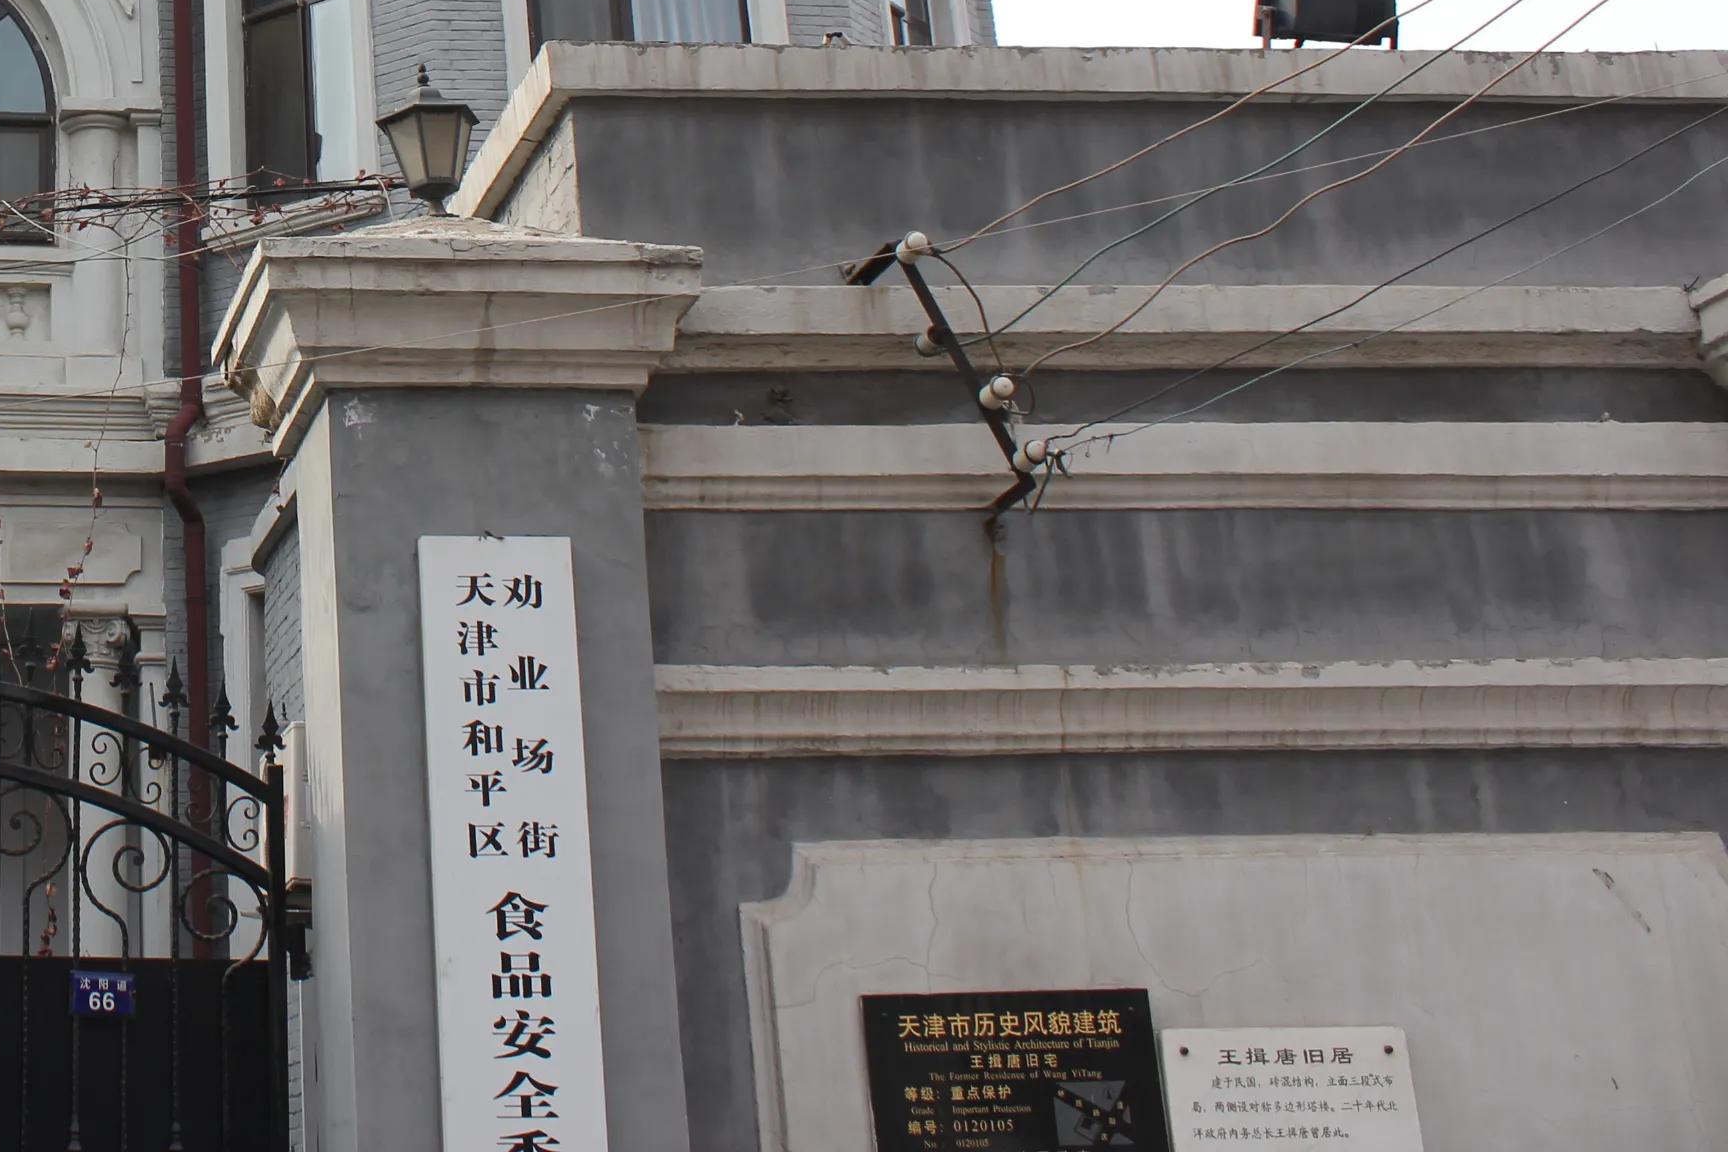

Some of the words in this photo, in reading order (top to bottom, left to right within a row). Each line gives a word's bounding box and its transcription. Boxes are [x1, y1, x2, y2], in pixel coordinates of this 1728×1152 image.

[455, 573, 508, 858] 天津市和平区
[501, 574, 560, 858] 劝业场街
[89, 992, 115, 1011] 66
[898, 1010, 1122, 1039] 天津市历史风貌建筑
[904, 1041, 949, 1053] Historical
[953, 1041, 969, 1051] and
[973, 1039, 1010, 1052] Stylistic
[1014, 1039, 1069, 1050] Architecture
[1073, 1039, 1084, 1048] of
[1087, 1038, 1119, 1050] Tianjin
[970, 1054, 1059, 1069] 王揖唐旧宅
[1218, 1047, 1354, 1065] 王揖唐旧居
[929, 1072, 945, 1081] The
[949, 1072, 979, 1081] Former
[984, 1071, 1025, 1080] Residence
[1030, 1071, 1039, 1080] of
[1042, 1070, 1067, 1080] Wang
[1071, 1069, 1102, 1080] YiTang
[951, 1085, 1011, 1101] 重点保护
[952, 1106, 989, 1115] Important
[993, 1104, 1032, 1113] Protection
[953, 1119, 1014, 1132] 0120105
